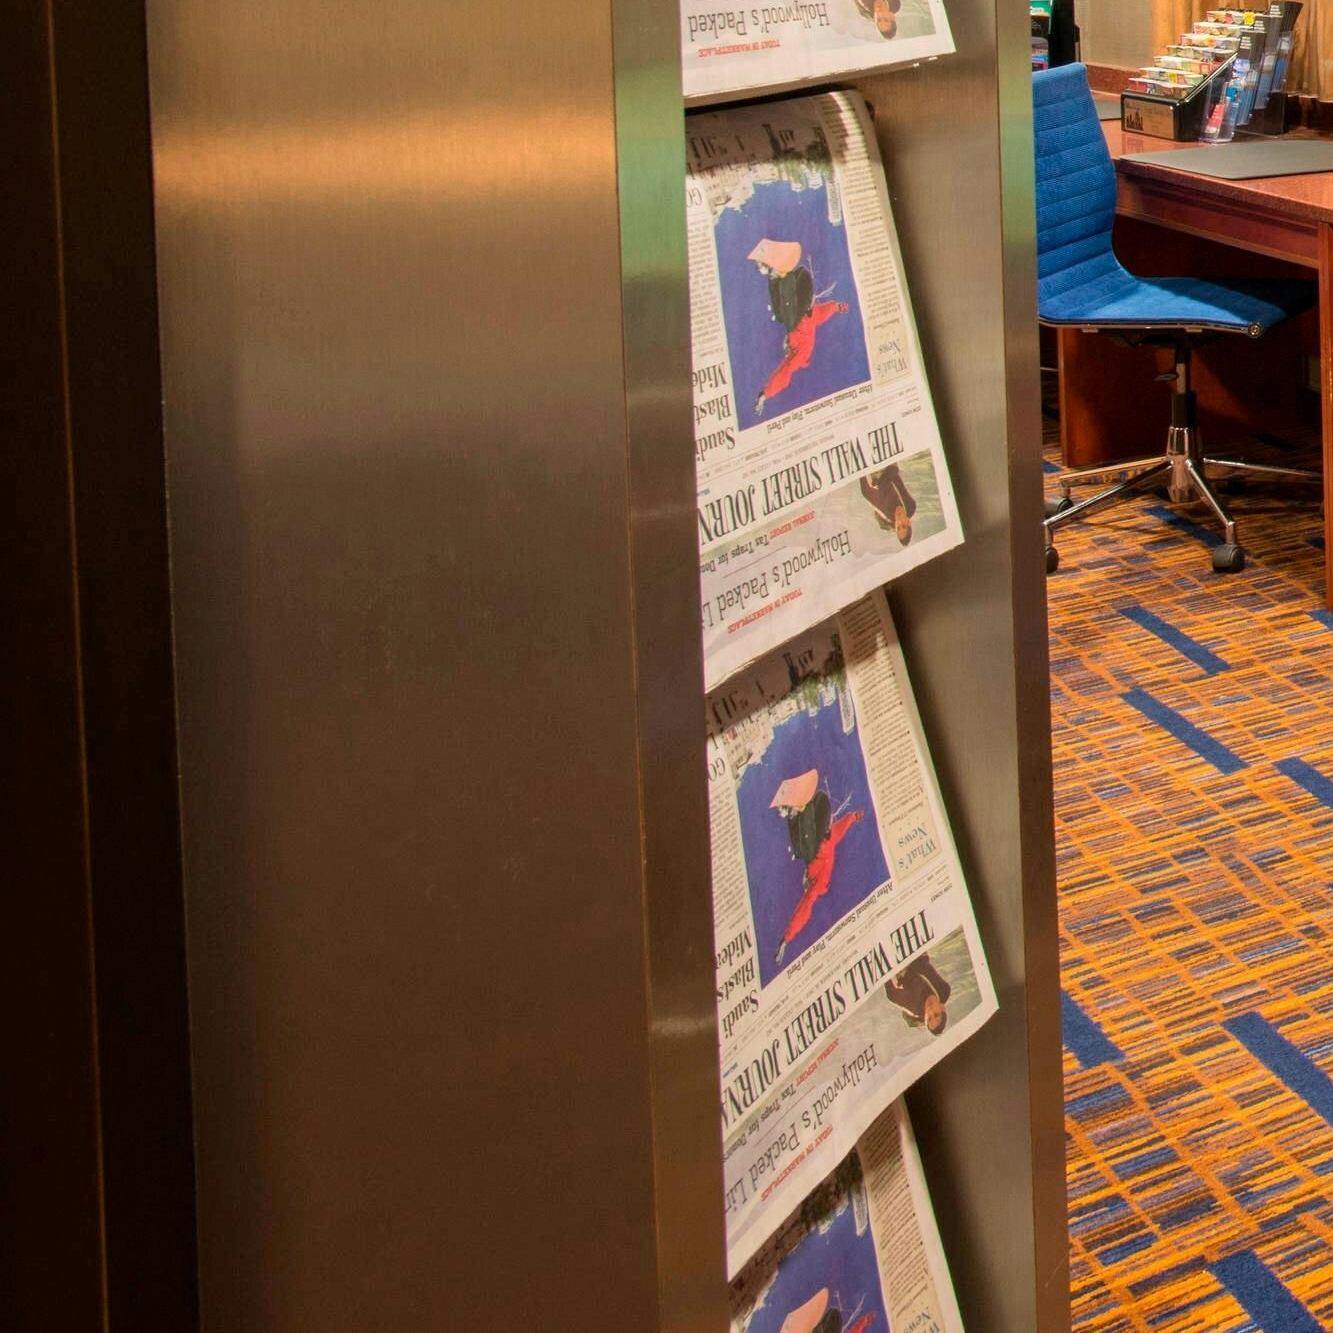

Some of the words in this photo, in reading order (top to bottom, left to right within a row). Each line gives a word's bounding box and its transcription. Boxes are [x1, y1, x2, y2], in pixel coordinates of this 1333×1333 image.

[687, 10, 748, 42] Packed
[751, 0, 830, 33] Hollywood's
[691, 362, 727, 393] Mide
[693, 394, 731, 426] Blast
[867, 421, 904, 465] THE
[820, 437, 869, 484] WALL
[760, 456, 822, 516] STREET
[696, 485, 757, 546] JOURN
[731, 542, 754, 558] Traps
[755, 534, 769, 547] Tax
[717, 552, 729, 566] for
[772, 530, 852, 587] Hollywood's
[716, 572, 769, 621] Packed
[897, 825, 928, 848] News
[898, 838, 937, 870] What's
[877, 882, 893, 898] After
[890, 910, 935, 964] THE
[843, 940, 893, 1003] WALL
[722, 988, 760, 1039] Saudi
[782, 980, 846, 1066] STREET
[781, 1083, 796, 1100] Tax
[801, 1043, 879, 1132] Hollywood's
[760, 1100, 780, 1121] Traps
[748, 1121, 760, 1136] for
[749, 1122, 801, 1193] Packed
